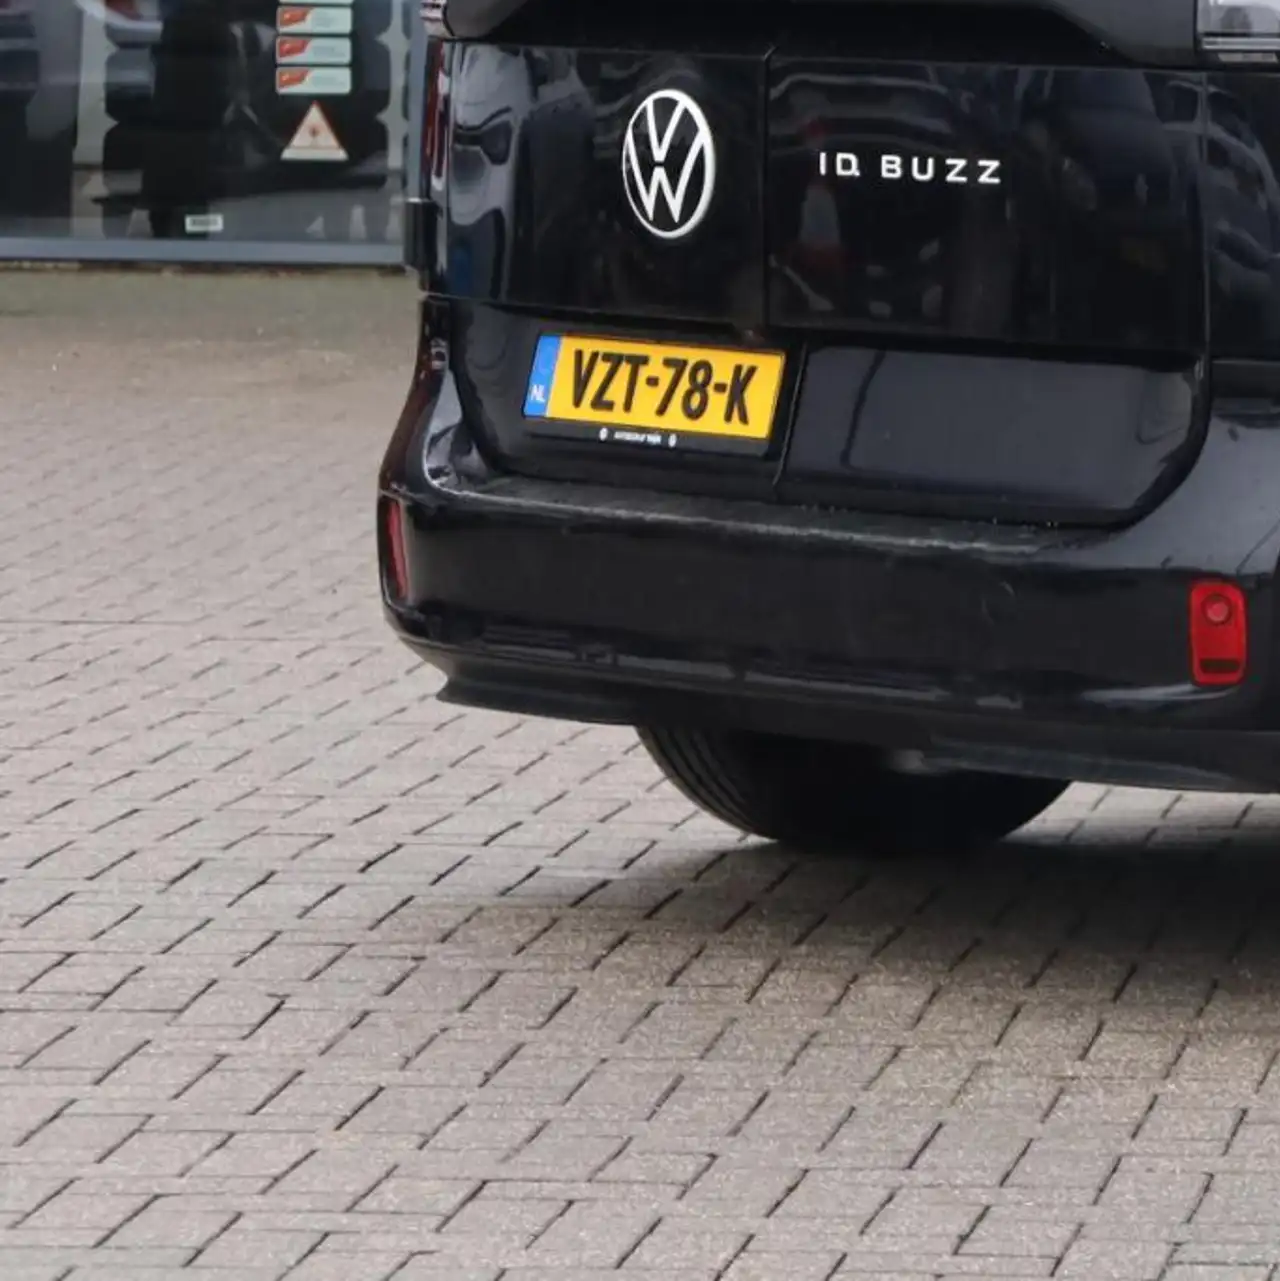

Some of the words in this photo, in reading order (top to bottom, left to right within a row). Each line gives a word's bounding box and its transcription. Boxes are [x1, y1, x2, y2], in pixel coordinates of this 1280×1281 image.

[623, 89, 716, 239] VW
[880, 154, 1002, 185] BUZZ
[571, 348, 758, 425] VZT-78-K
